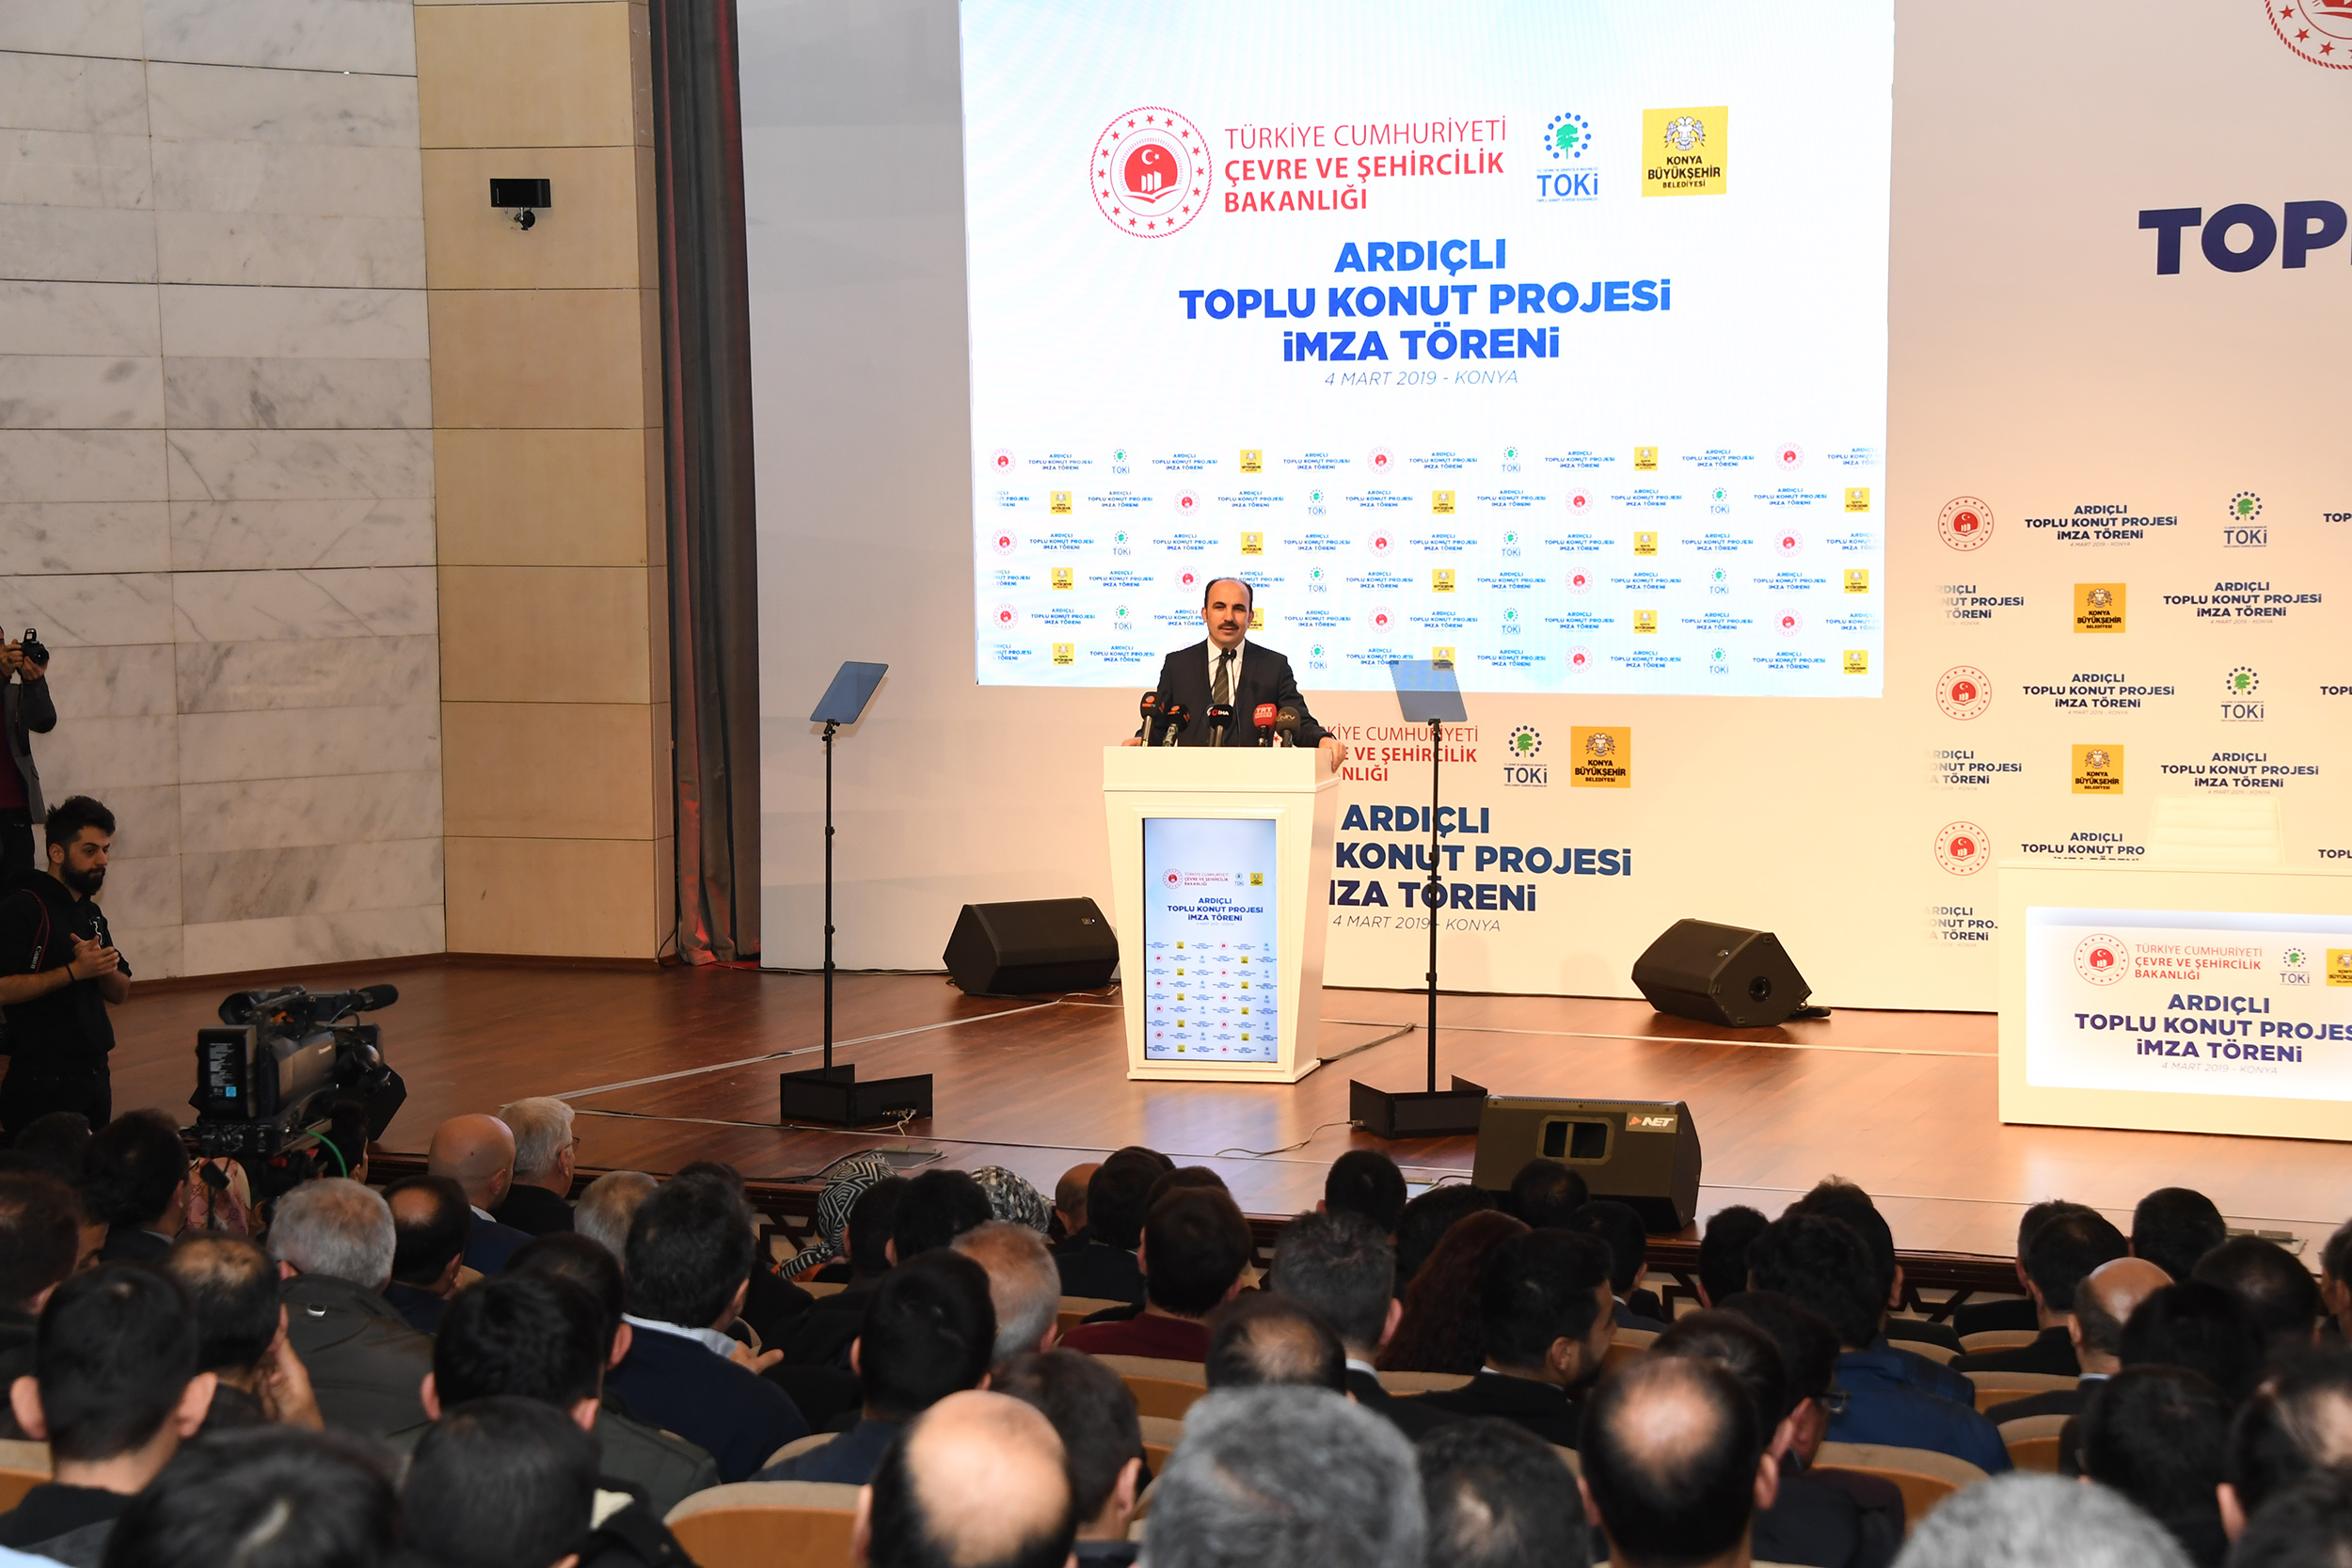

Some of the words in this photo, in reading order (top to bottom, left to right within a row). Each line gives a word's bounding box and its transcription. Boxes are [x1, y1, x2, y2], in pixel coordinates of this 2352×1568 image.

[1225, 122, 1325, 149] TÜRKİYE
[1666, 156, 1702, 166] KONYA
[1225, 158, 1307, 184] ÇEVRE
[1316, 157, 1348, 179] VE
[1225, 183, 1366, 213] BAKANLIĞI
[2138, 200, 2352, 275] TOP
[1334, 239, 1505, 277] ARDIÇLI
[1179, 288, 1315, 320] TOPLU
[1328, 284, 1477, 317] KONUT
[1325, 372, 1334, 386] 4
[1342, 372, 1392, 386] MART
[1396, 371, 1437, 385] 2019
[1454, 370, 1518, 384] KONYA
[2074, 505, 2127, 515] ARDIÇLI
[2025, 519, 2068, 528] TOPLU
[2072, 517, 2118, 528] KONUT
[2215, 582, 2269, 593] ARDIÇLI
[2164, 595, 2207, 604] TOPLU
[2212, 594, 2260, 604] KONUT
[2072, 673, 2124, 684] ARDIÇLI
[2070, 687, 2115, 695] KONUT
[1326, 723, 1360, 740] KİYE
[1355, 747, 1375, 760] VE
[2212, 752, 2266, 763] ARDIÇLI
[1343, 765, 1388, 781] NLIĞI
[2161, 766, 2205, 774] TOPLU
[2209, 766, 2257, 775] KONUT
[1341, 804, 1488, 837] ARDIÇLI
[2070, 832, 2122, 843] ARDIÇLI
[2021, 844, 2064, 853] TOPLU
[2068, 845, 2113, 855] KONUT
[1336, 843, 1464, 870] KONUT
[1333, 915, 1342, 926] 4
[1347, 916, 1391, 927] MART
[1395, 917, 1430, 929] 2019
[1446, 919, 1500, 931] KONYA
[2136, 943, 2181, 955] TÜRKİYE
[2135, 957, 2172, 967] ÇEVRE
[2176, 958, 2191, 967] VE
[2135, 970, 2200, 980] BAKANLIĞI
[2168, 994, 2269, 1016] ARDIÇLI
[2074, 1014, 2156, 1032] TOPLU
[2164, 1018, 2252, 1037] KONUT
[2261, 1021, 2352, 1041] PROJES
[1642, 1117, 1674, 1127] NET
